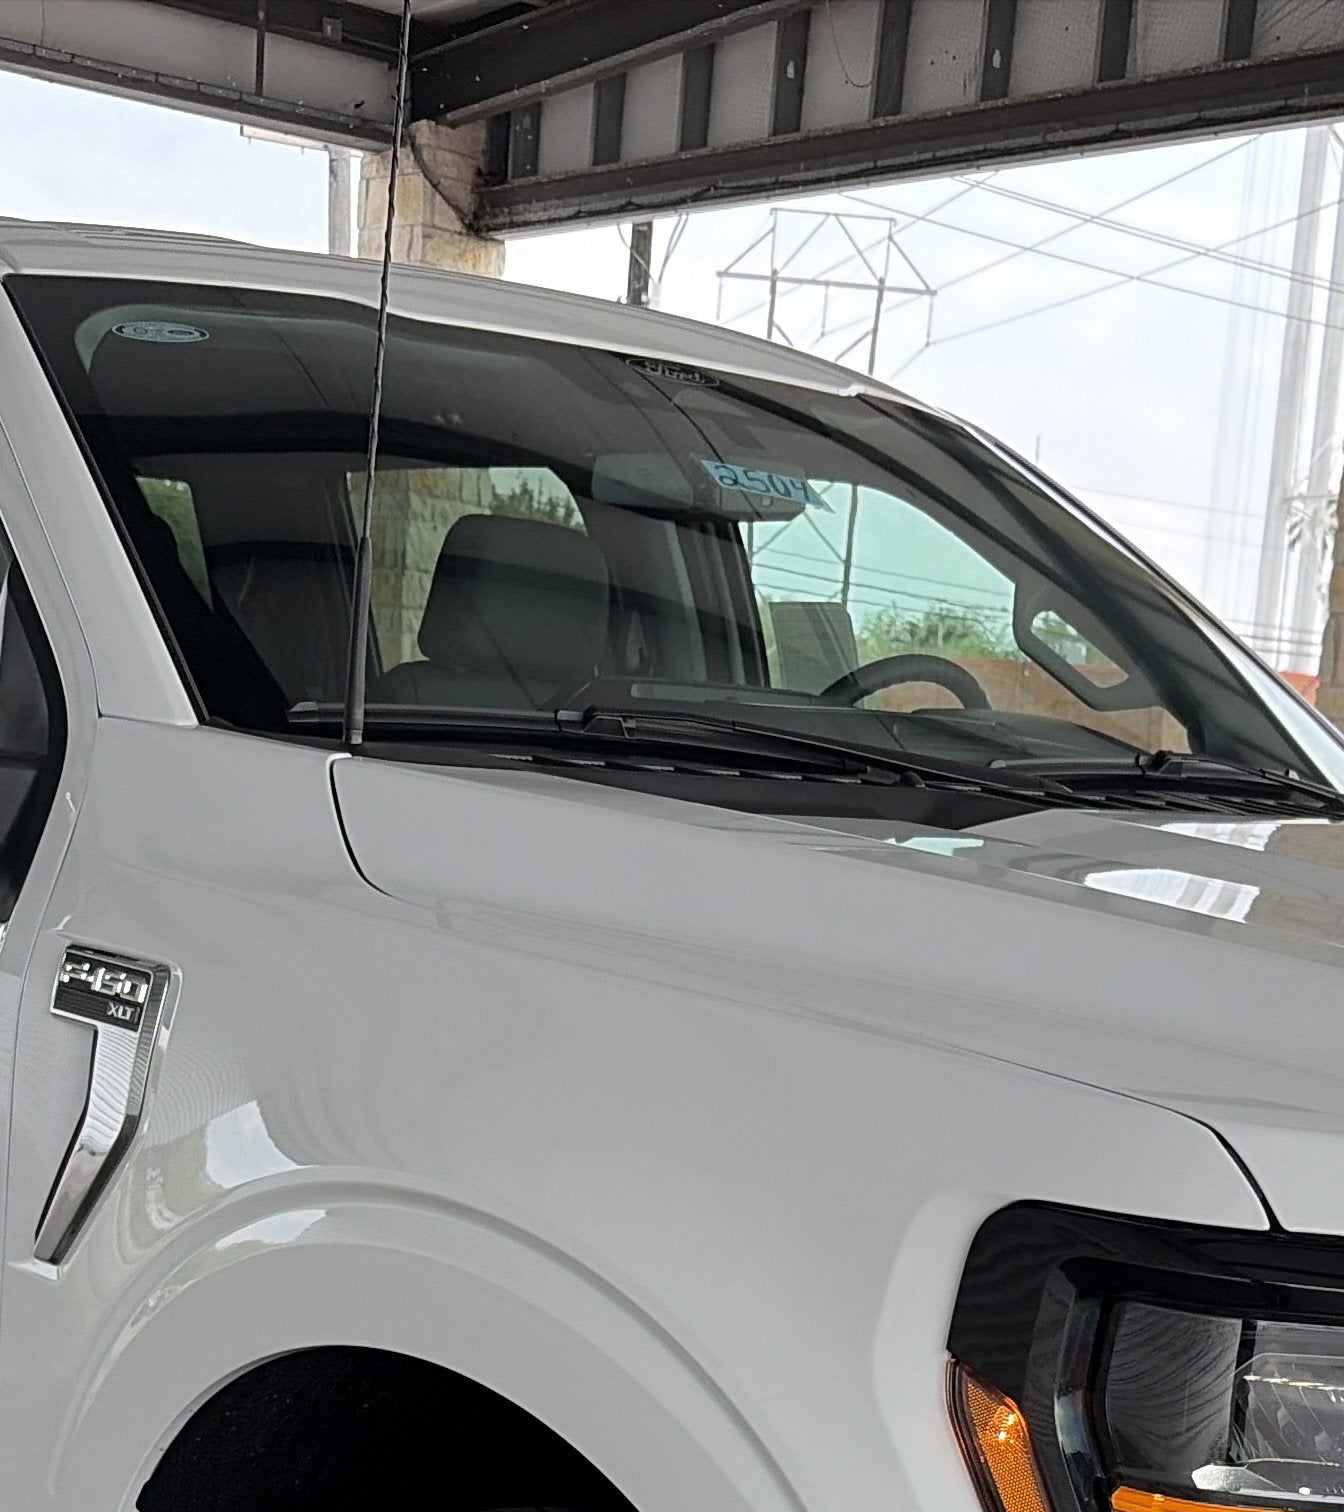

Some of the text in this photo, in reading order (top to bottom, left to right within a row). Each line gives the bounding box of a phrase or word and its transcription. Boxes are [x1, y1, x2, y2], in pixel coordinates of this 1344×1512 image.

[714, 464, 811, 502] 2504
[58, 961, 149, 1004] F-150
[106, 1001, 135, 1021] XLT
